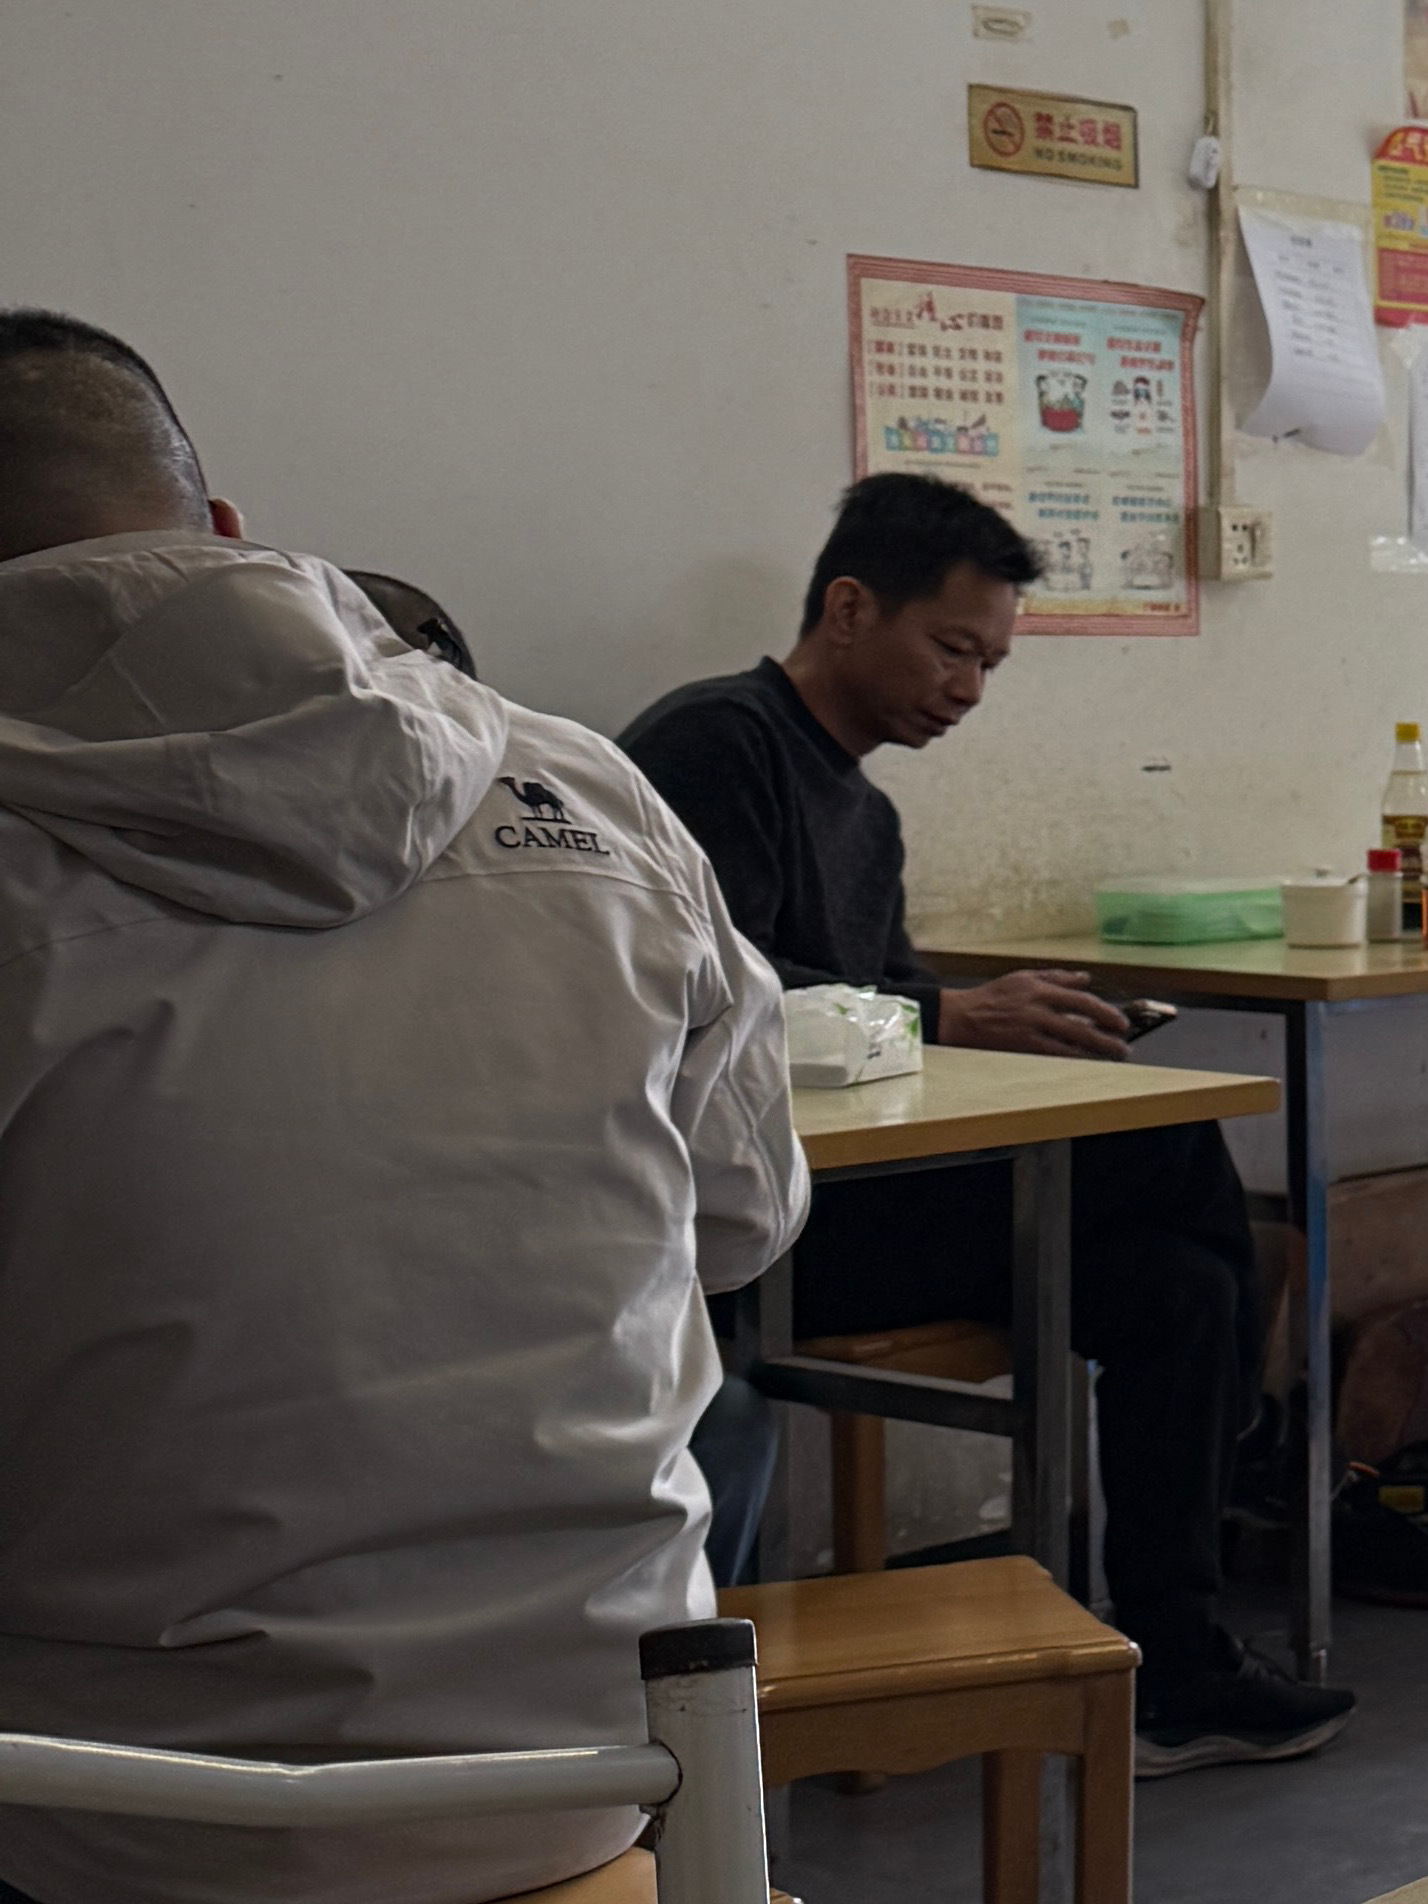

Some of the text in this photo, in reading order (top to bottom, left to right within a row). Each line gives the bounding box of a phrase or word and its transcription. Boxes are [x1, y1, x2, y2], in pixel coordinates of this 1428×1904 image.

[1034, 111, 1122, 151] 禁止吸烟
[494, 825, 610, 856] CAMEL
